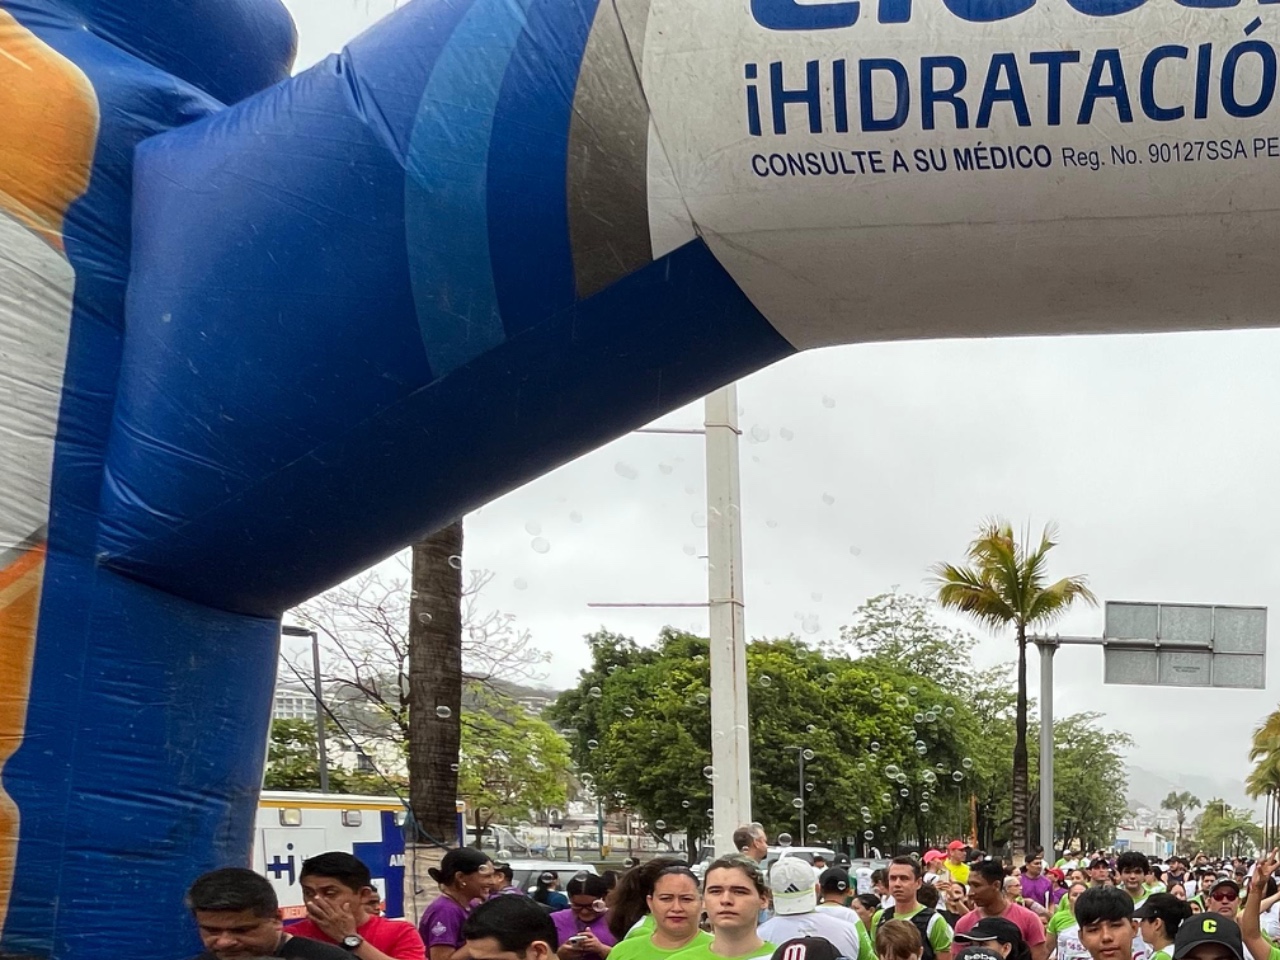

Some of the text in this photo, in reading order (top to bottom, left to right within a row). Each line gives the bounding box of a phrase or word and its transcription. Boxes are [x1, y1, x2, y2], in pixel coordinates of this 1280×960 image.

[751, 150, 886, 178] CONSULTE
[892, 150, 909, 173] A
[914, 147, 947, 172] SU
[954, 141, 1052, 171] MÉDICO
[1063, 146, 1105, 171] Reg.
[1111, 144, 1143, 166] No.
[1149, 140, 1248, 164] 90127SSA
[1203, 918, 1218, 933] C
